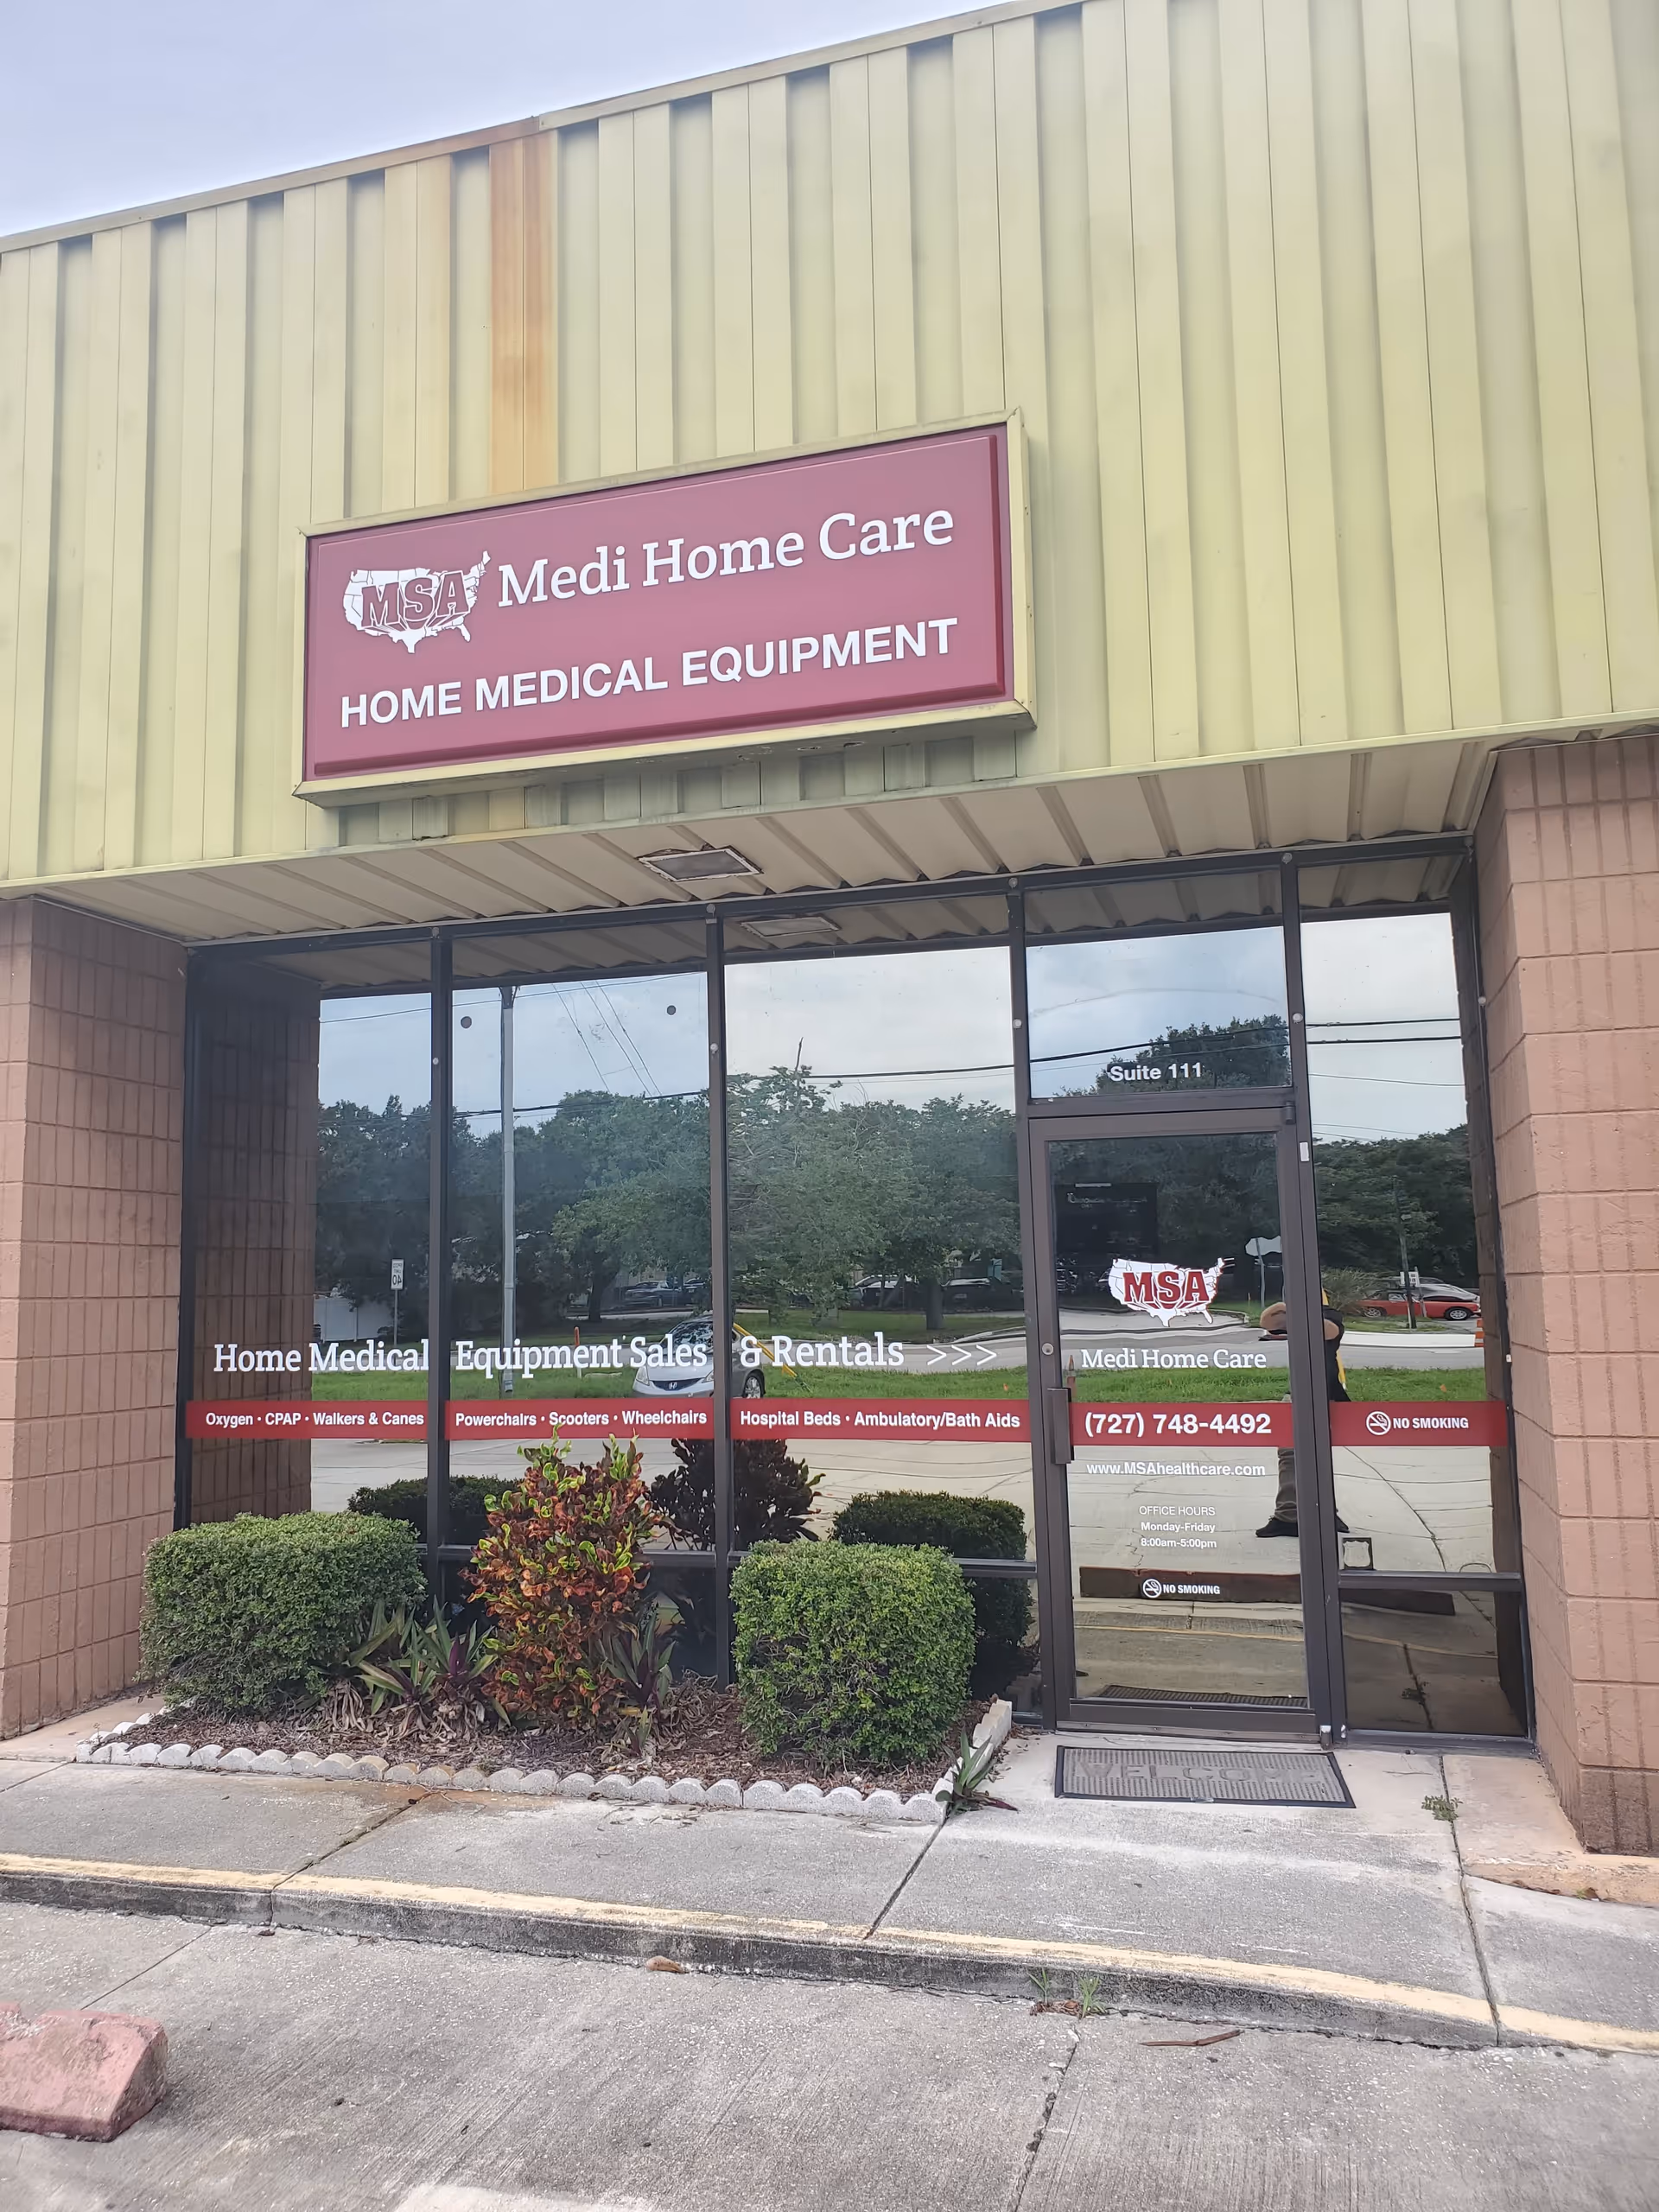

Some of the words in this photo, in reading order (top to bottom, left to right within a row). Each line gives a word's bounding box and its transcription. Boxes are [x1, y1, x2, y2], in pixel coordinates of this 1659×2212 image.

[498, 545, 630, 607] Medi
[642, 531, 804, 587] Home
[819, 509, 954, 560] Care
[361, 569, 471, 629] MSA
[341, 681, 462, 728] HOME
[476, 656, 669, 711] MEDICAL
[682, 617, 958, 687] EQUIPMENT
[1110, 1065, 1162, 1082] Suite
[1168, 1062, 1202, 1079] 111
[1122, 1269, 1211, 1306] MSA
[213, 1344, 302, 1372] Home
[308, 1339, 429, 1371] Medical
[454, 1338, 624, 1379] Equipment
[630, 1334, 708, 1369] Sales
[740, 1336, 762, 1368] &
[771, 1332, 905, 1367] Rentals
[1081, 1348, 1136, 1369] Medi
[1141, 1349, 1209, 1368] Home
[1213, 1349, 1267, 1369] Care
[206, 1412, 254, 1428] Oxygen
[264, 1413, 302, 1426] CPAP
[313, 1412, 365, 1426] Walkers
[368, 1413, 378, 1426] &
[382, 1412, 424, 1426] Canes
[455, 1412, 537, 1427] Powerchairs
[549, 1411, 609, 1427] Scooters
[621, 1410, 707, 1426] Wheelchairs
[741, 1410, 799, 1429] Hospital
[804, 1412, 841, 1426] Beds
[854, 1411, 981, 1430] Ambulatory/Bath
[985, 1413, 1020, 1428] Aids
[1085, 1412, 1144, 1438] (727)
[1153, 1413, 1272, 1434] 748-4492
[1393, 1418, 1410, 1429] NO
[1412, 1417, 1469, 1429] SMOKING
[1086, 1461, 1266, 1477] www.MSAhealthcare.com
[1139, 1506, 1176, 1516] OFFICE
[1178, 1506, 1216, 1516] HOURS
[1141, 1522, 1216, 1534] Monday-Friday
[1141, 1538, 1217, 1549] 8:00am-5:00pm
[1163, 1584, 1176, 1594] NO
[1178, 1585, 1221, 1595] SMOKING
[1079, 1762, 1321, 1782] WELCOME
